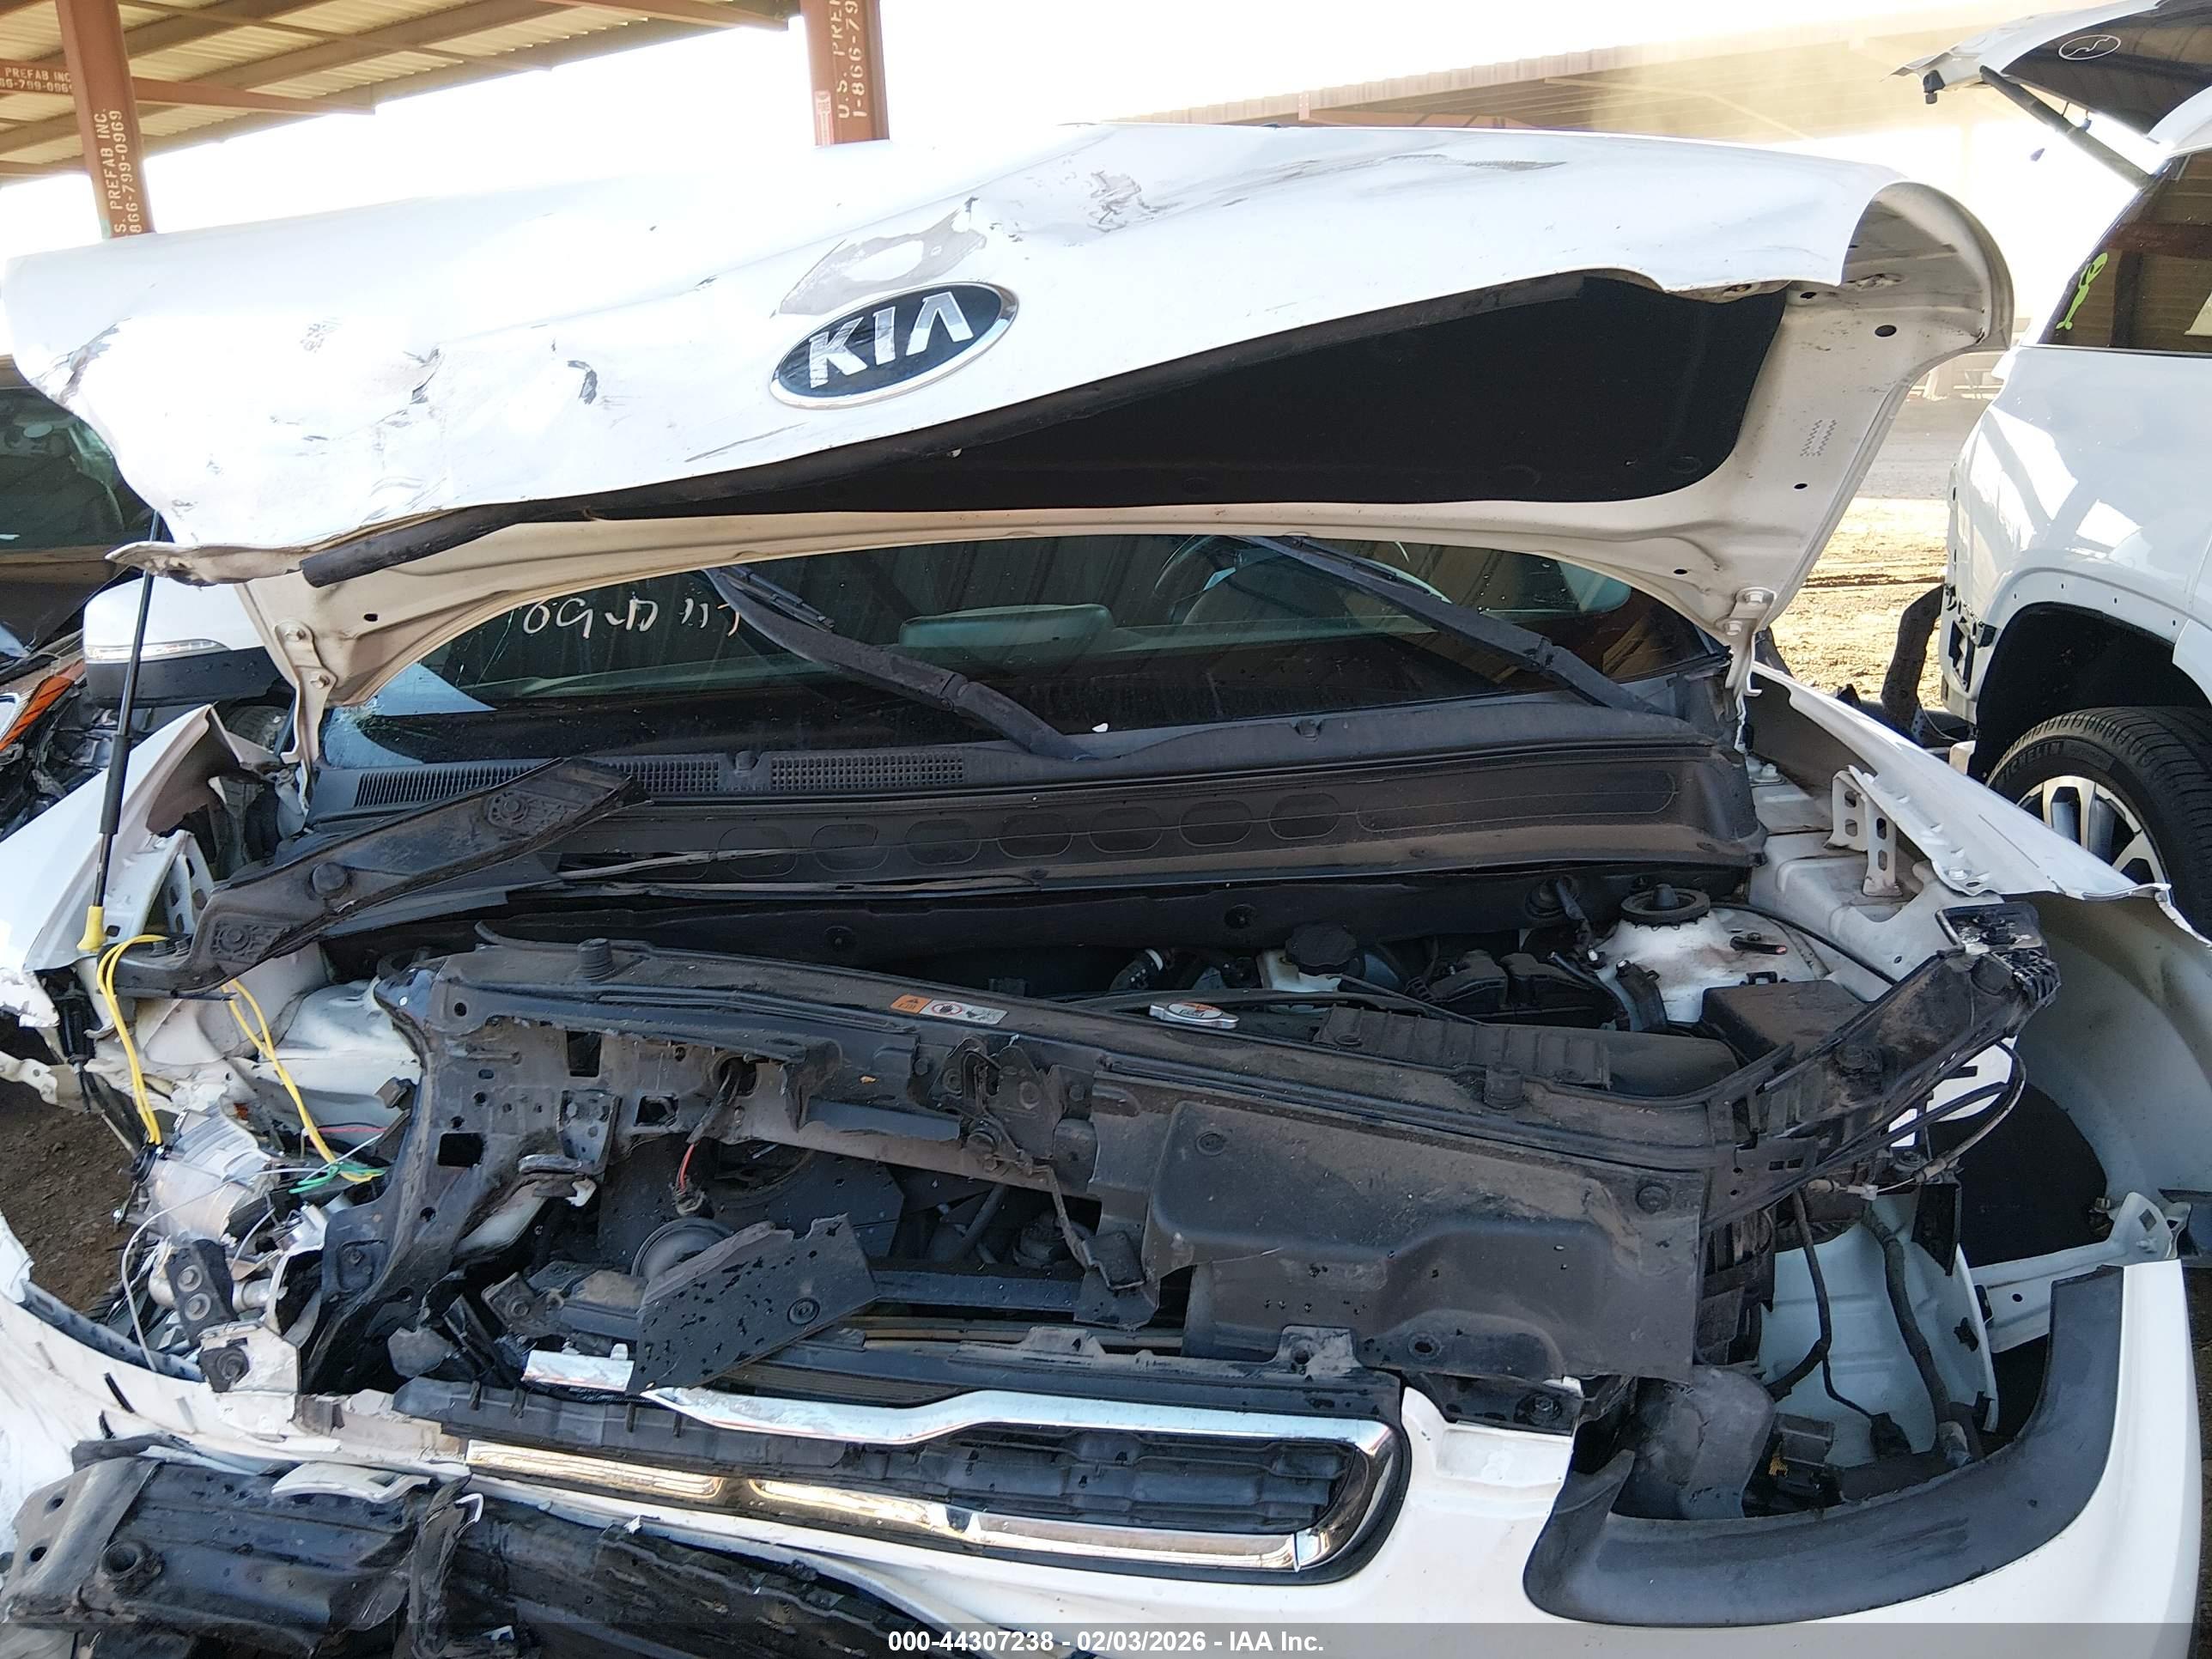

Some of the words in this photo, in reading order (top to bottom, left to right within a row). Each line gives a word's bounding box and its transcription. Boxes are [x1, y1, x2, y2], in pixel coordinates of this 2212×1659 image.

[5, 67, 49, 81] PREFAB
[100, 147, 124, 210] PREFAB
[108, 110, 143, 234] 866-799-0969
[808, 291, 974, 389] KIA
